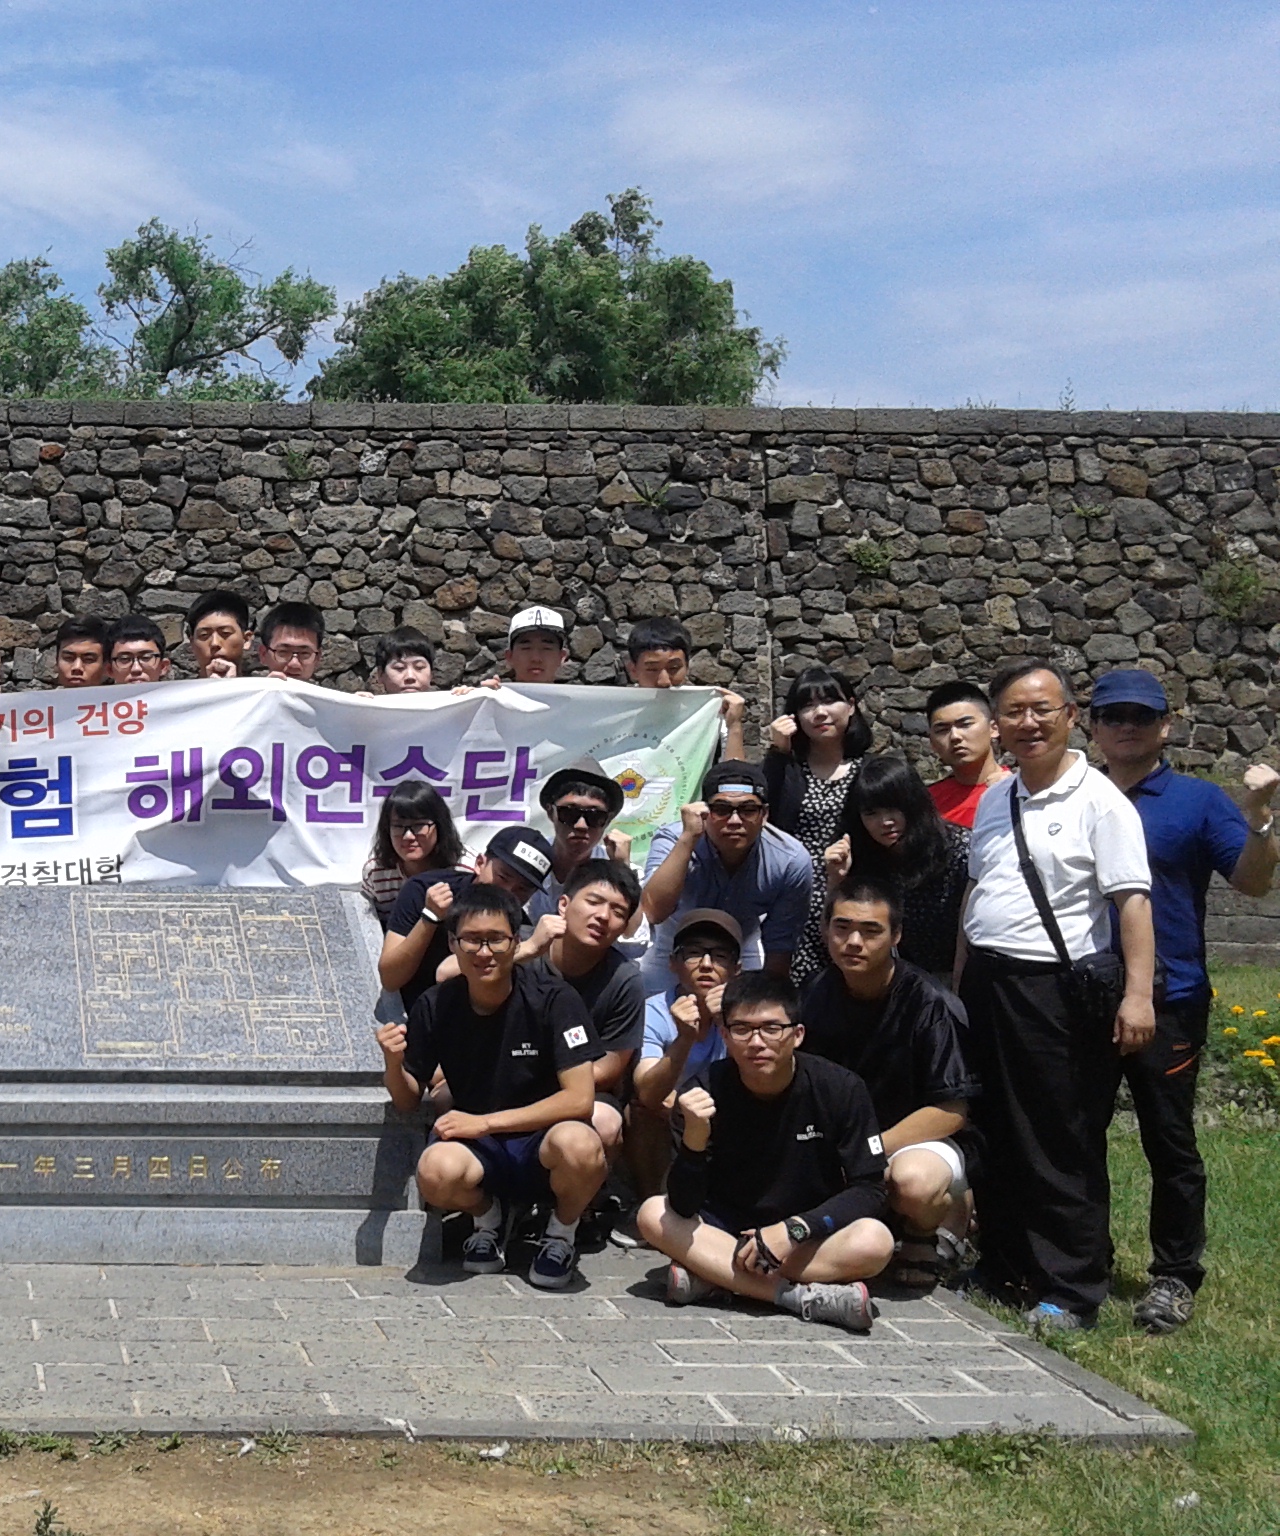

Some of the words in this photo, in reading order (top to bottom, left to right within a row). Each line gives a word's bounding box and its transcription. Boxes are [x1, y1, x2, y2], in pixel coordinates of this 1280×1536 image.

[76, 699, 149, 736] 건양
[125, 742, 537, 823] 해외연수단
[520, 847, 549, 869] BLACK
